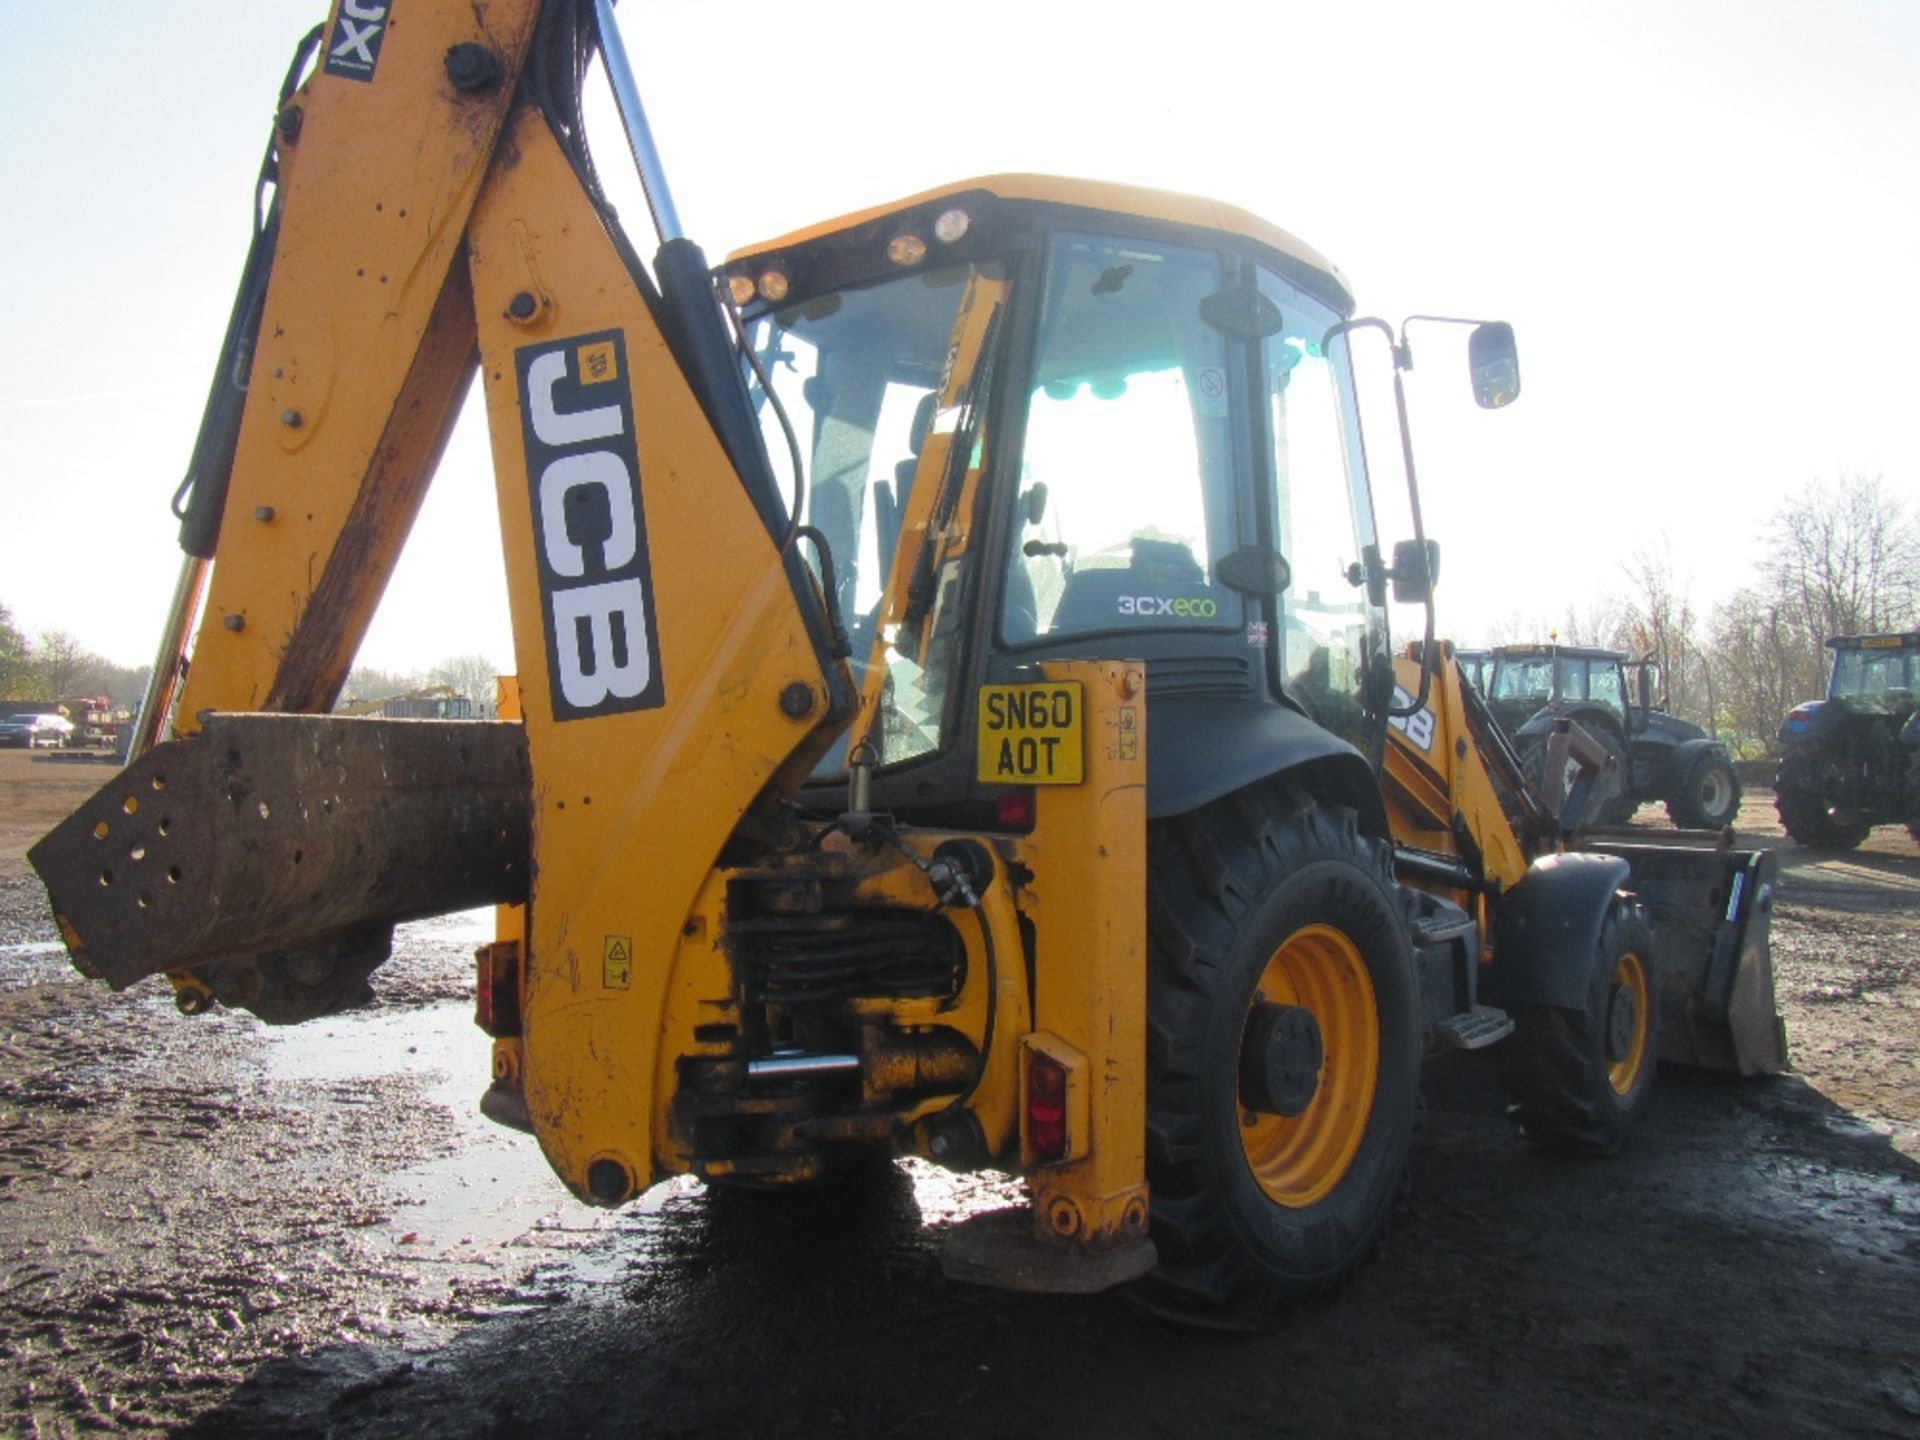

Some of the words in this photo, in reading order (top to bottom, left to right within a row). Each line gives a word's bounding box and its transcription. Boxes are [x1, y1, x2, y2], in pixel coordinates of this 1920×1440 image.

[527, 349, 650, 708] JCB
[987, 690, 1072, 730] SN60
[997, 736, 1061, 775] AOT
